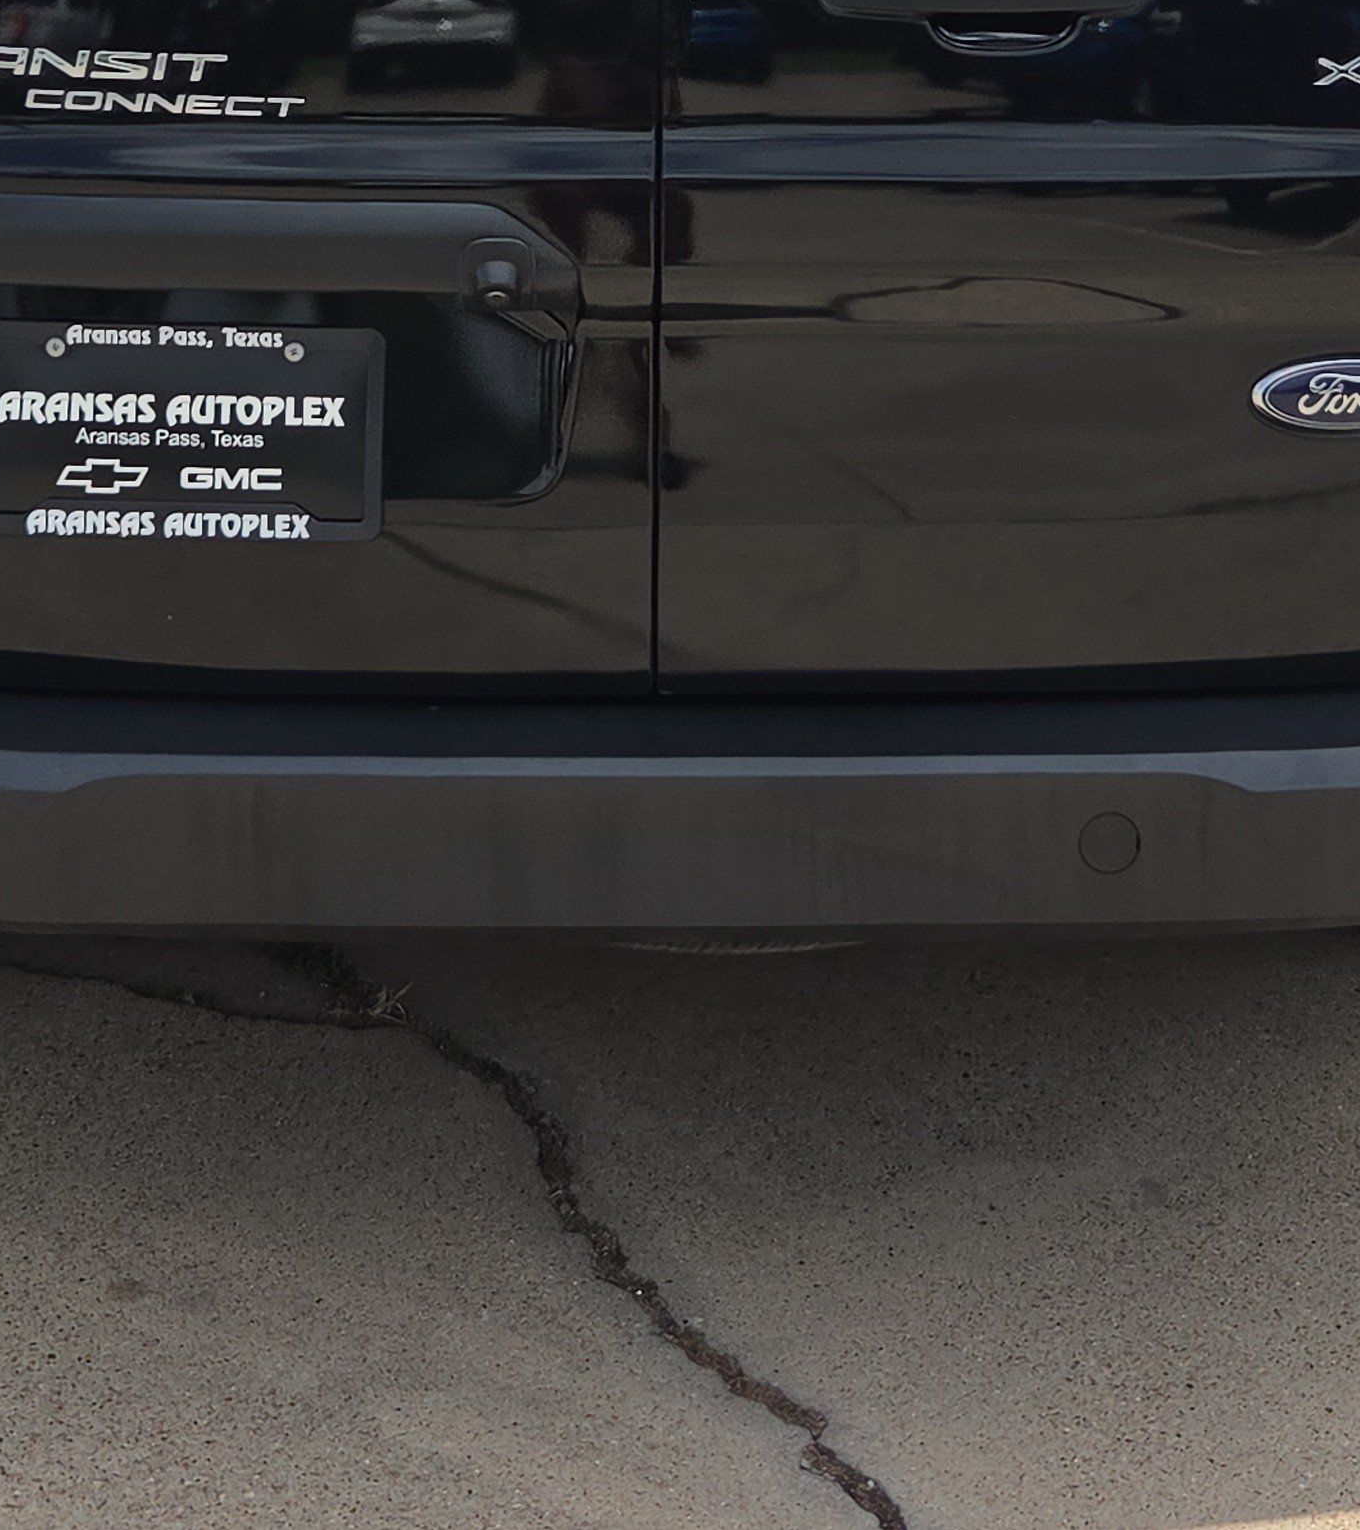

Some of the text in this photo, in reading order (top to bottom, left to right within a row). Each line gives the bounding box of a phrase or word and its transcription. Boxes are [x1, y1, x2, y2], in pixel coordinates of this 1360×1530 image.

[24, 88, 306, 118] CONNECT
[66, 324, 283, 349] Aransas Pass, Texas
[165, 394, 346, 428] AUTOPLEX
[75, 427, 264, 450] Aransas Pass, Texas
[179, 467, 283, 491] GMC
[26, 508, 311, 539] ARANSAS AUTOPLEX
